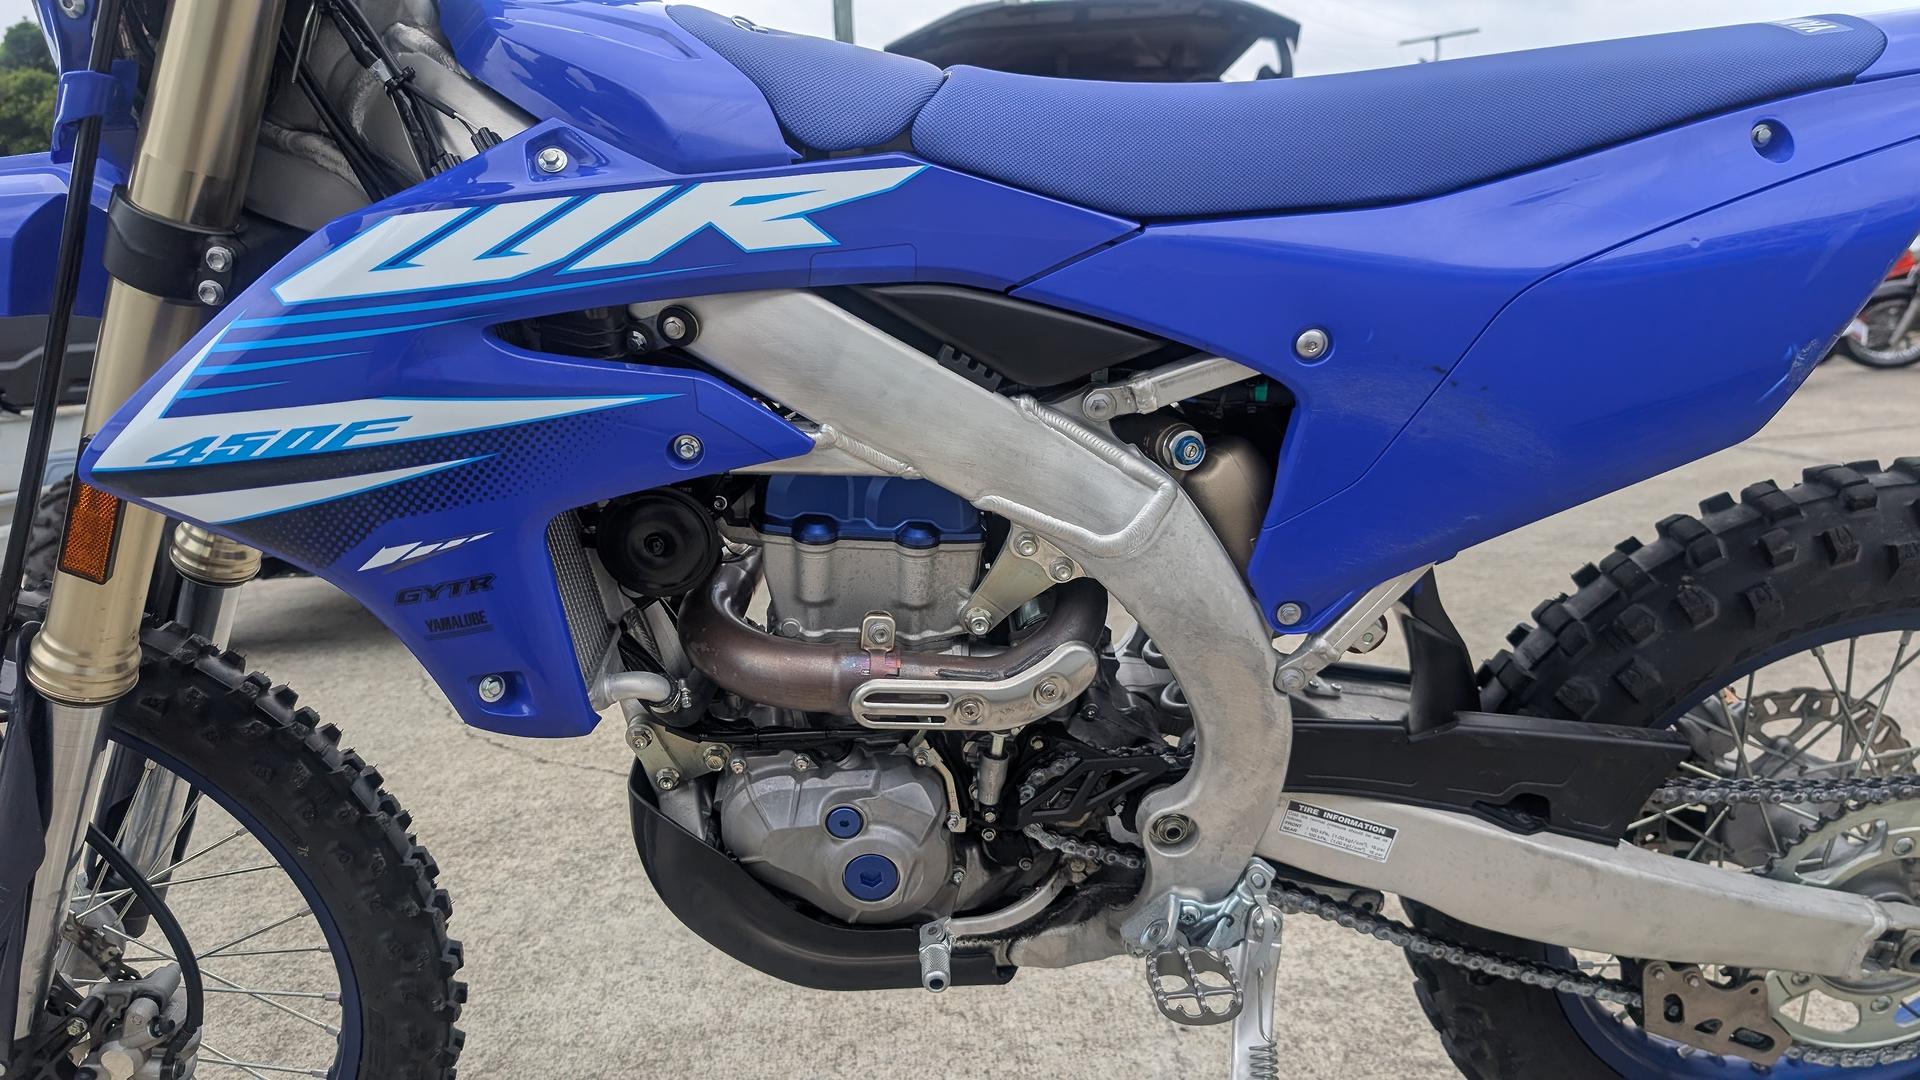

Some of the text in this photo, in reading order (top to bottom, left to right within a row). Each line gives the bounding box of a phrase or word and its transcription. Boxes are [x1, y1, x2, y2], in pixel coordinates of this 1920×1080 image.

[272, 164, 925, 305] WR
[144, 415, 414, 465] 450F
[395, 573, 496, 605] GYTR
[424, 610, 488, 633] YAMALUBE
[1298, 804, 1320, 816] TIRE
[1323, 811, 1386, 835] INFORMATION
